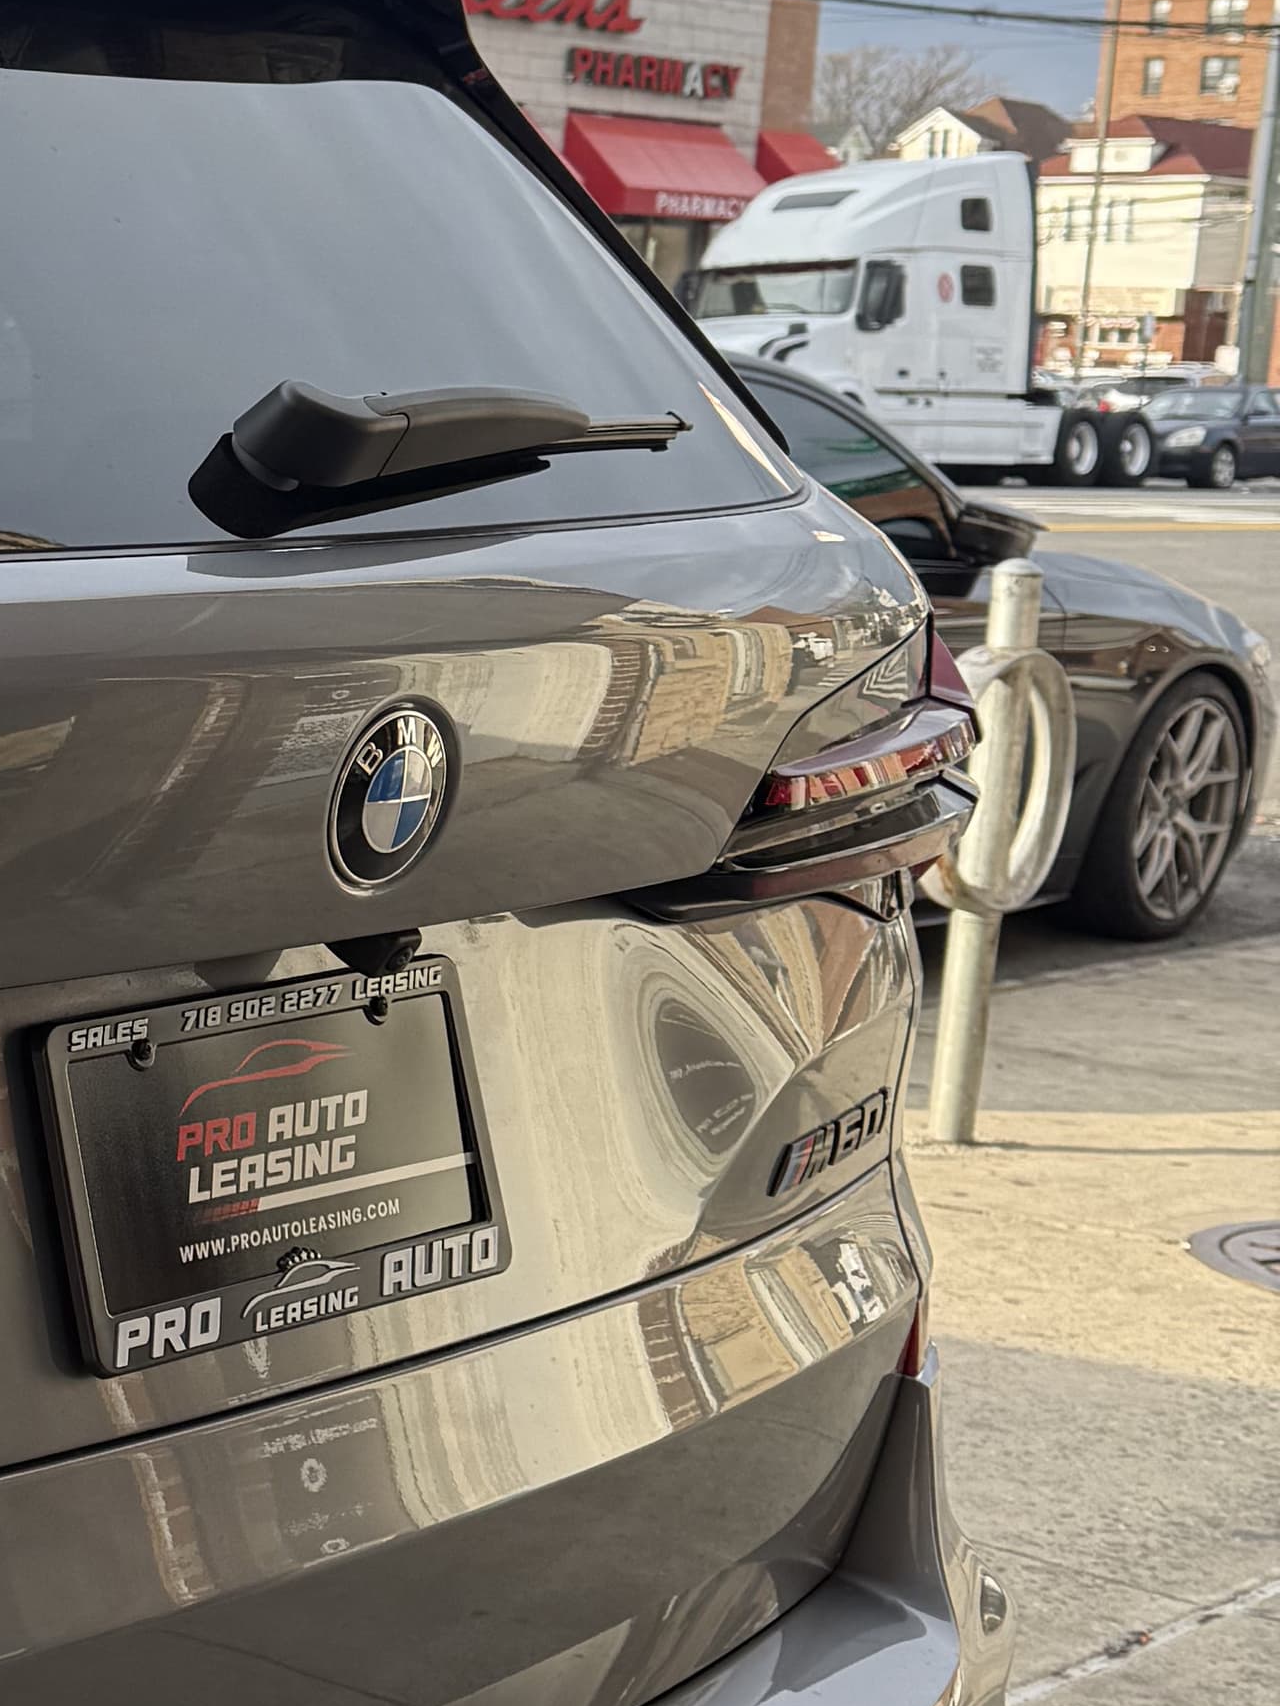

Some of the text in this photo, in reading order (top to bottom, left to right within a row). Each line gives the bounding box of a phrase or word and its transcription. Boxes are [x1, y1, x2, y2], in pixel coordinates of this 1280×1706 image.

[569, 47, 744, 99] PHARMACY
[356, 717, 443, 776] BMW
[70, 965, 443, 1053] SALES 718 902 2277 LEASING
[176, 1089, 369, 1162] PRO AUTO
[188, 1134, 356, 1204] LEASING
[178, 1198, 401, 1264] WWW.PROAUTOLEASING.COM
[115, 1225, 499, 1369] PRO AUTO
[254, 1286, 359, 1333] LEASING
